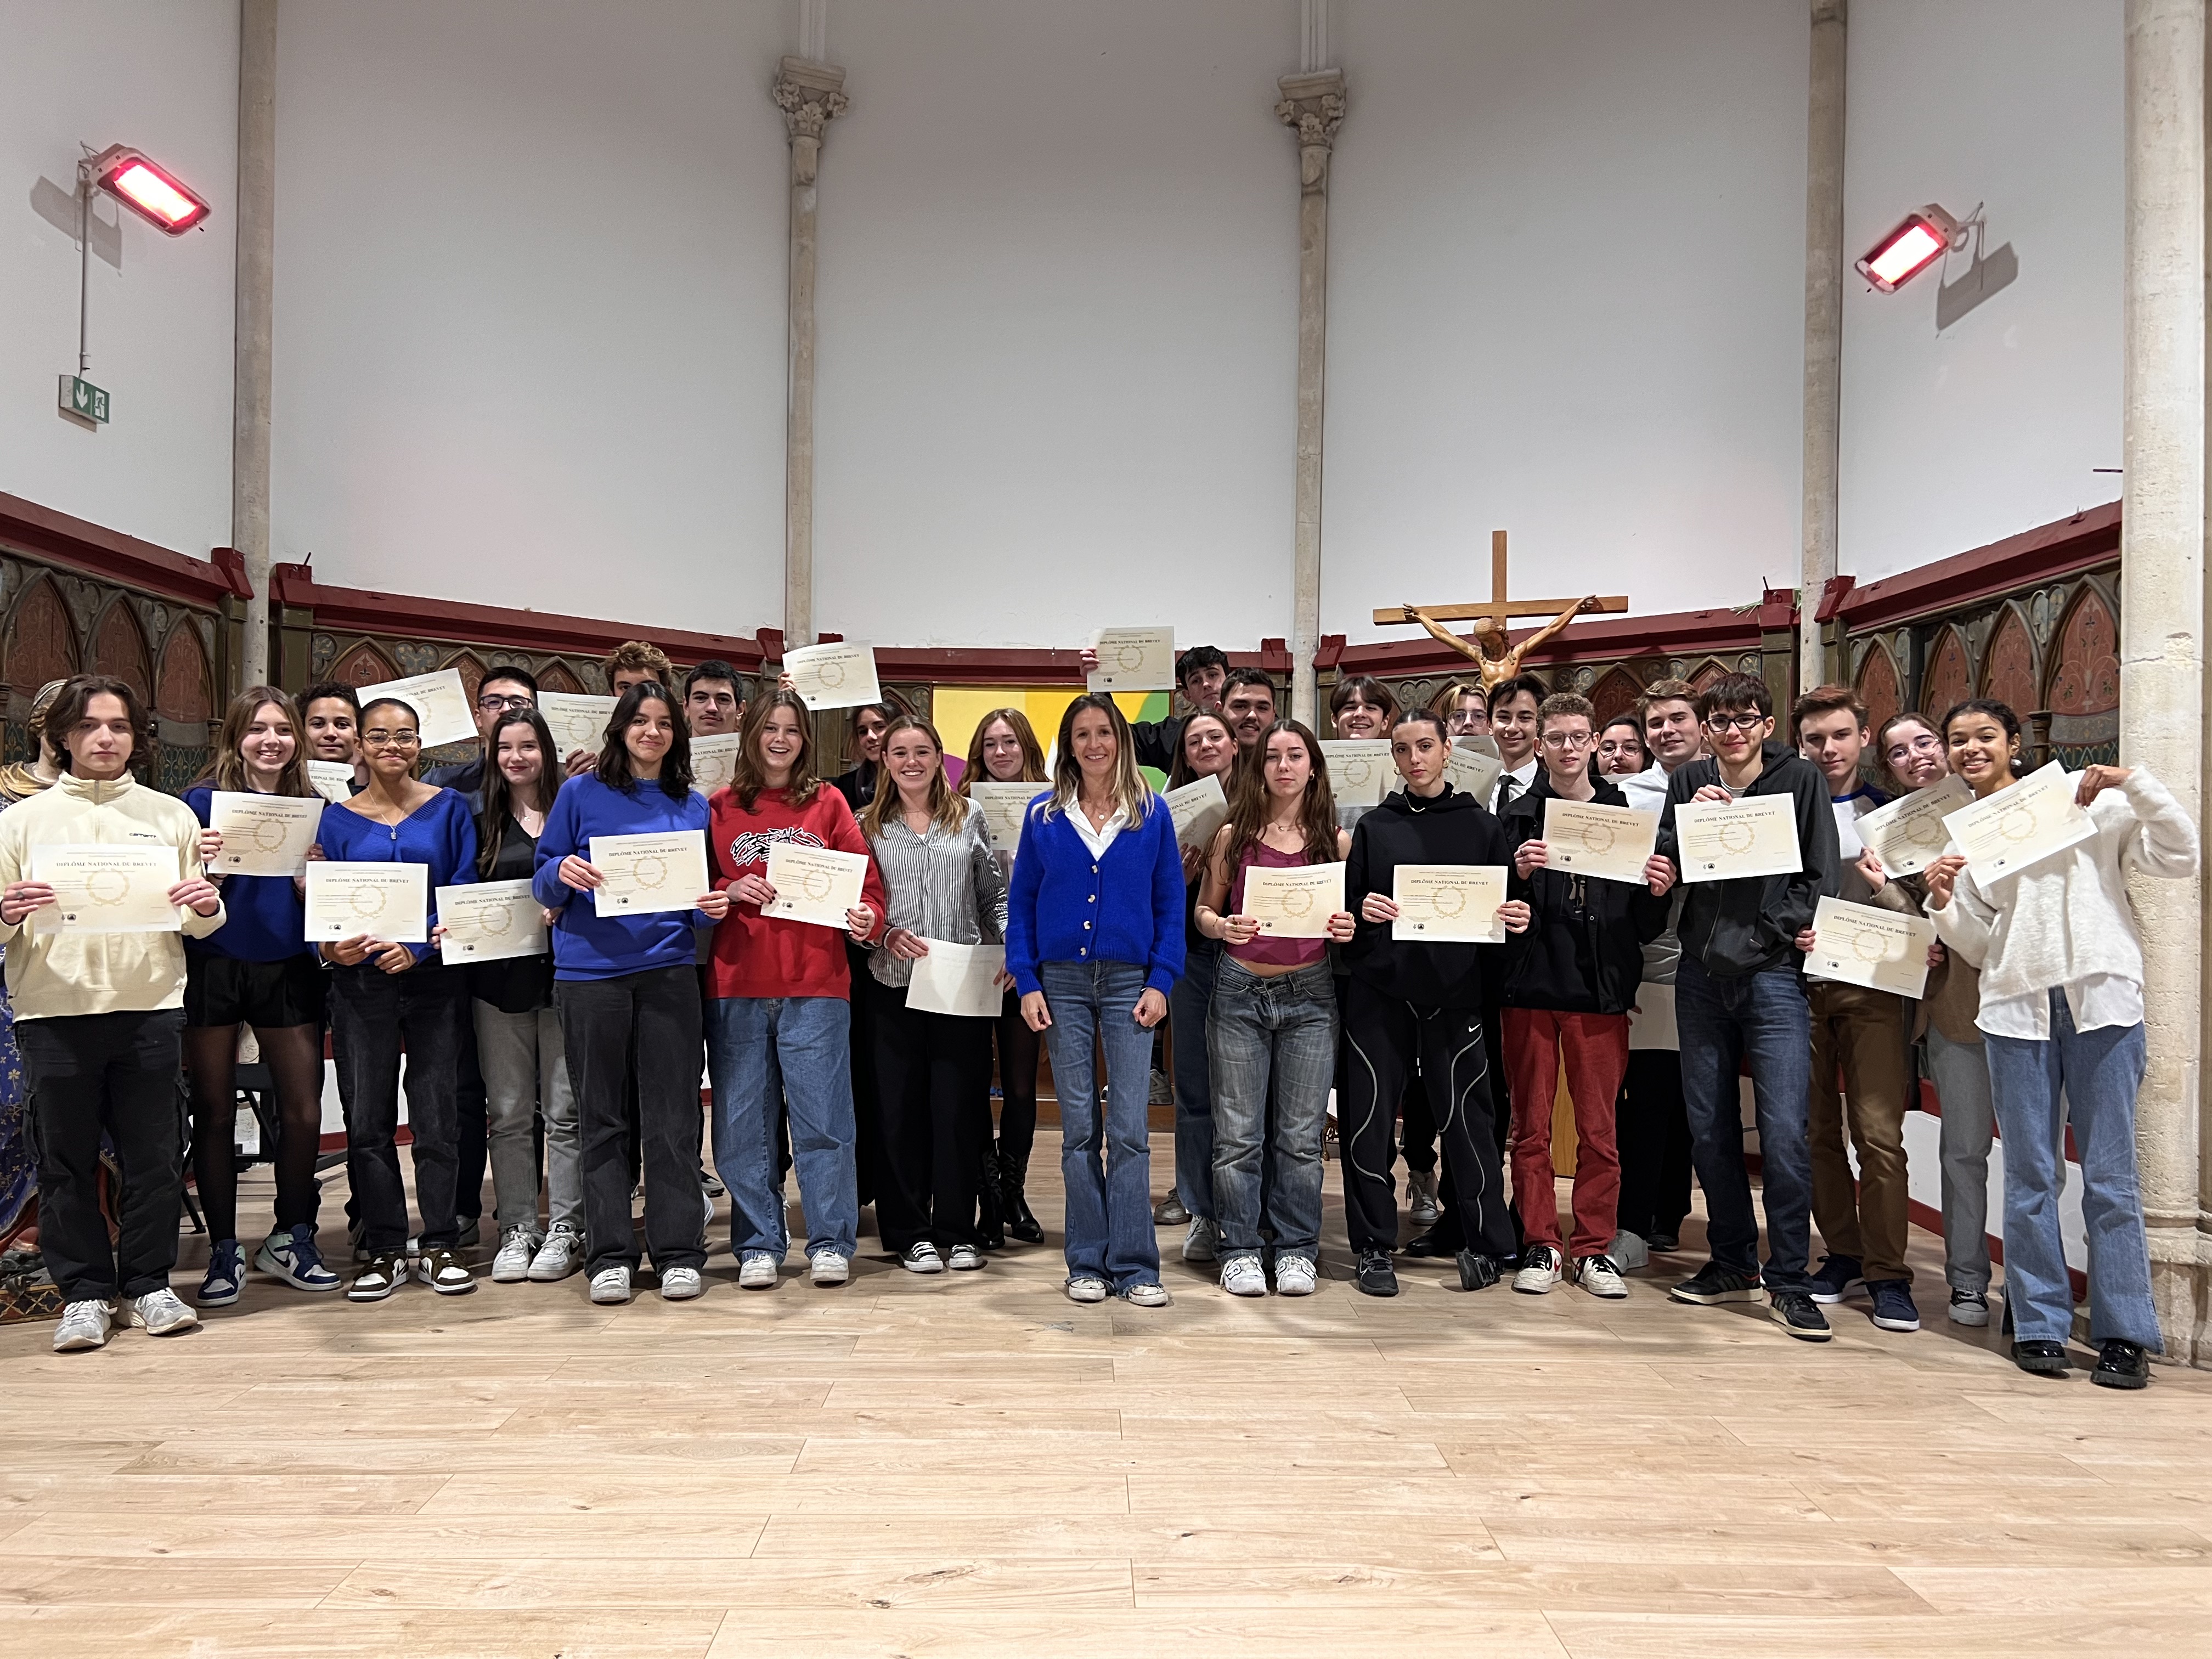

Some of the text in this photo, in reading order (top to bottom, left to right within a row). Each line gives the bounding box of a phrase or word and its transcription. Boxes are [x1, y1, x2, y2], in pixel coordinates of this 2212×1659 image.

[1191, 793, 1207, 803] BREVET
[1897, 809, 1922, 821] NATIONAL
[1931, 794, 1951, 805] BREVET
[1859, 920, 1885, 931] NATIONAL
[1895, 928, 1917, 937] BREVET
